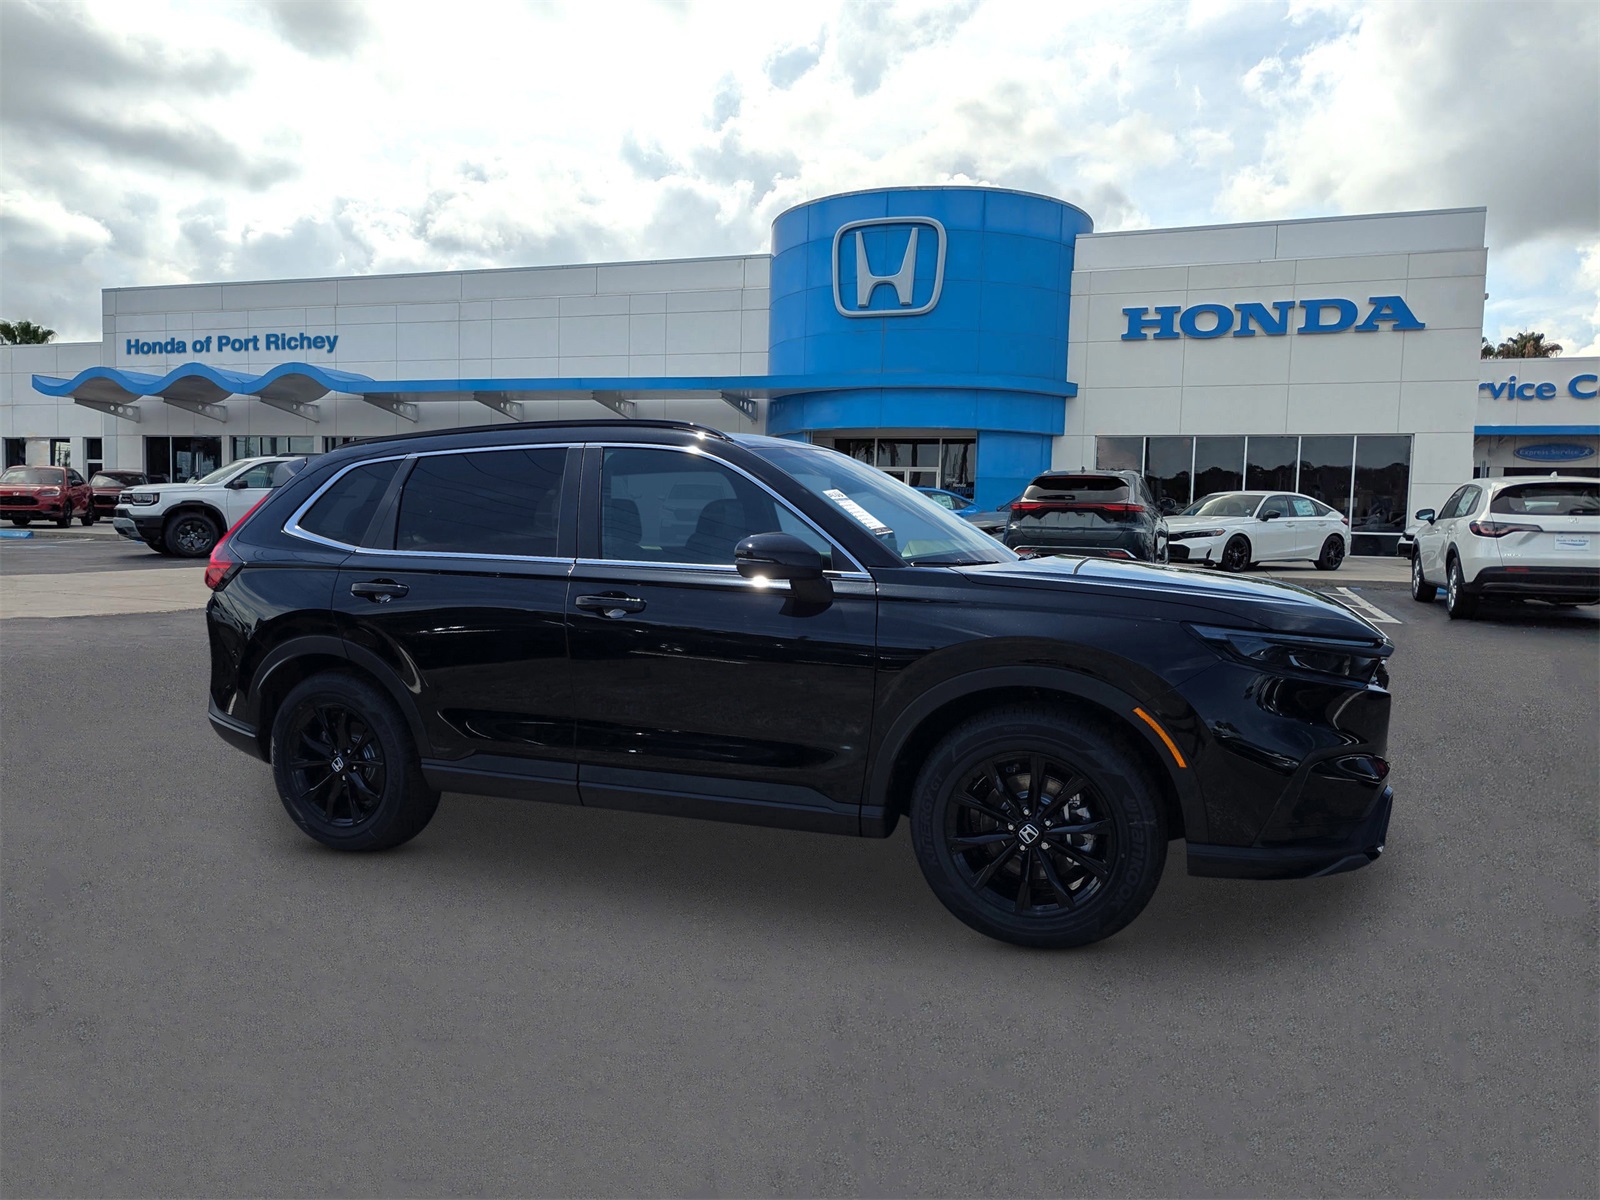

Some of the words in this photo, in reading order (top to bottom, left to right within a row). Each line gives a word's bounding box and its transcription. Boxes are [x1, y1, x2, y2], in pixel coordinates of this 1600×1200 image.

[1121, 295, 1426, 341] HONDA
[126, 337, 188, 355] Honda
[192, 335, 212, 353] of
[217, 334, 260, 352] Port
[265, 332, 339, 353] Richey
[1567, 373, 1600, 399] C
